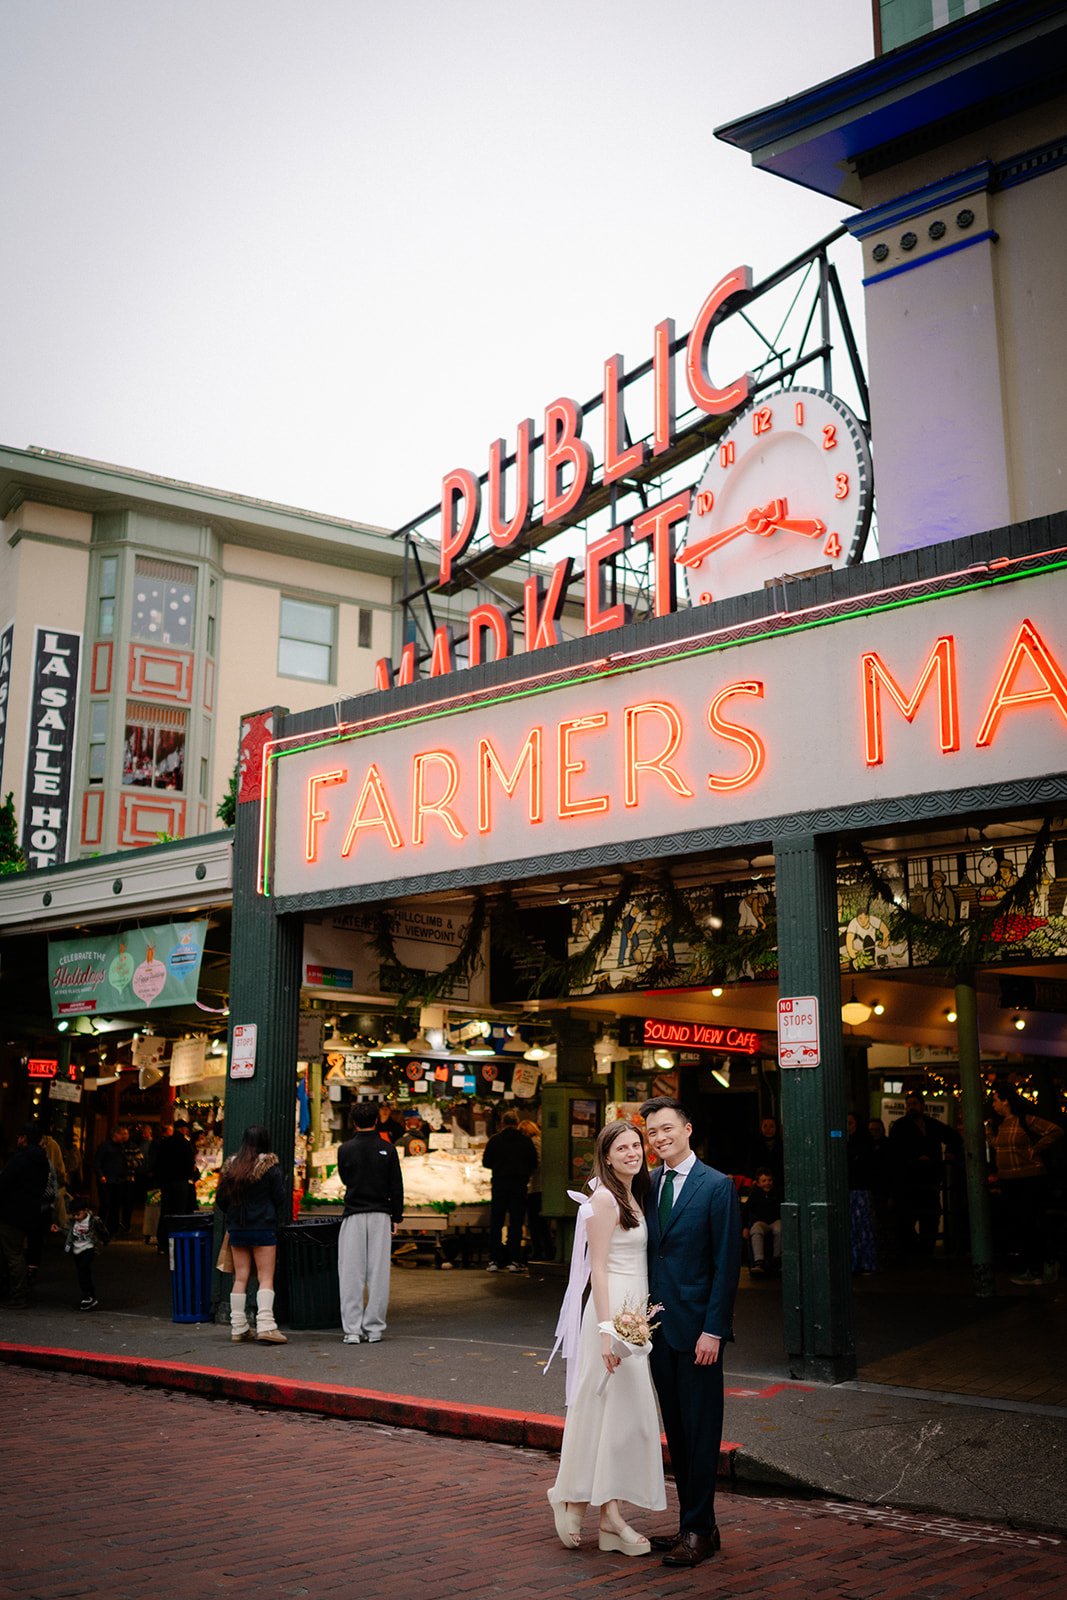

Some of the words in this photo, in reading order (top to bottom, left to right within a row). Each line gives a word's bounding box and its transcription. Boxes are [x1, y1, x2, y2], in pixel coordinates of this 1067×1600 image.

[439, 265, 753, 586] PUBLIC
[753, 406, 772, 435] 12
[795, 402, 804, 427] 1
[822, 424, 837, 450] 2
[720, 441, 735, 468] 11
[835, 472, 850, 500] 3
[696, 490, 714, 516] 10
[823, 532, 842, 559] 4
[41, 633, 71, 678] LA
[33, 687, 69, 797] SALLE
[306, 680, 764, 863] FARMERS
[395, 909, 443, 928] HILLCLIMB
[405, 924, 456, 942] VIEWPOINT
[59, 952, 93, 966] CELEBRATE
[93, 951, 107, 962] THE
[53, 966, 105, 991] Holidays
[779, 1000, 792, 1012] NO
[783, 1014, 813, 1027] STOPS
[644, 1020, 690, 1042] SOUND
[693, 1025, 724, 1044] VIEW
[727, 1028, 757, 1048] CAFE
[345, 1055, 372, 1064] PLACE
[345, 1070, 378, 1078] MARKET
